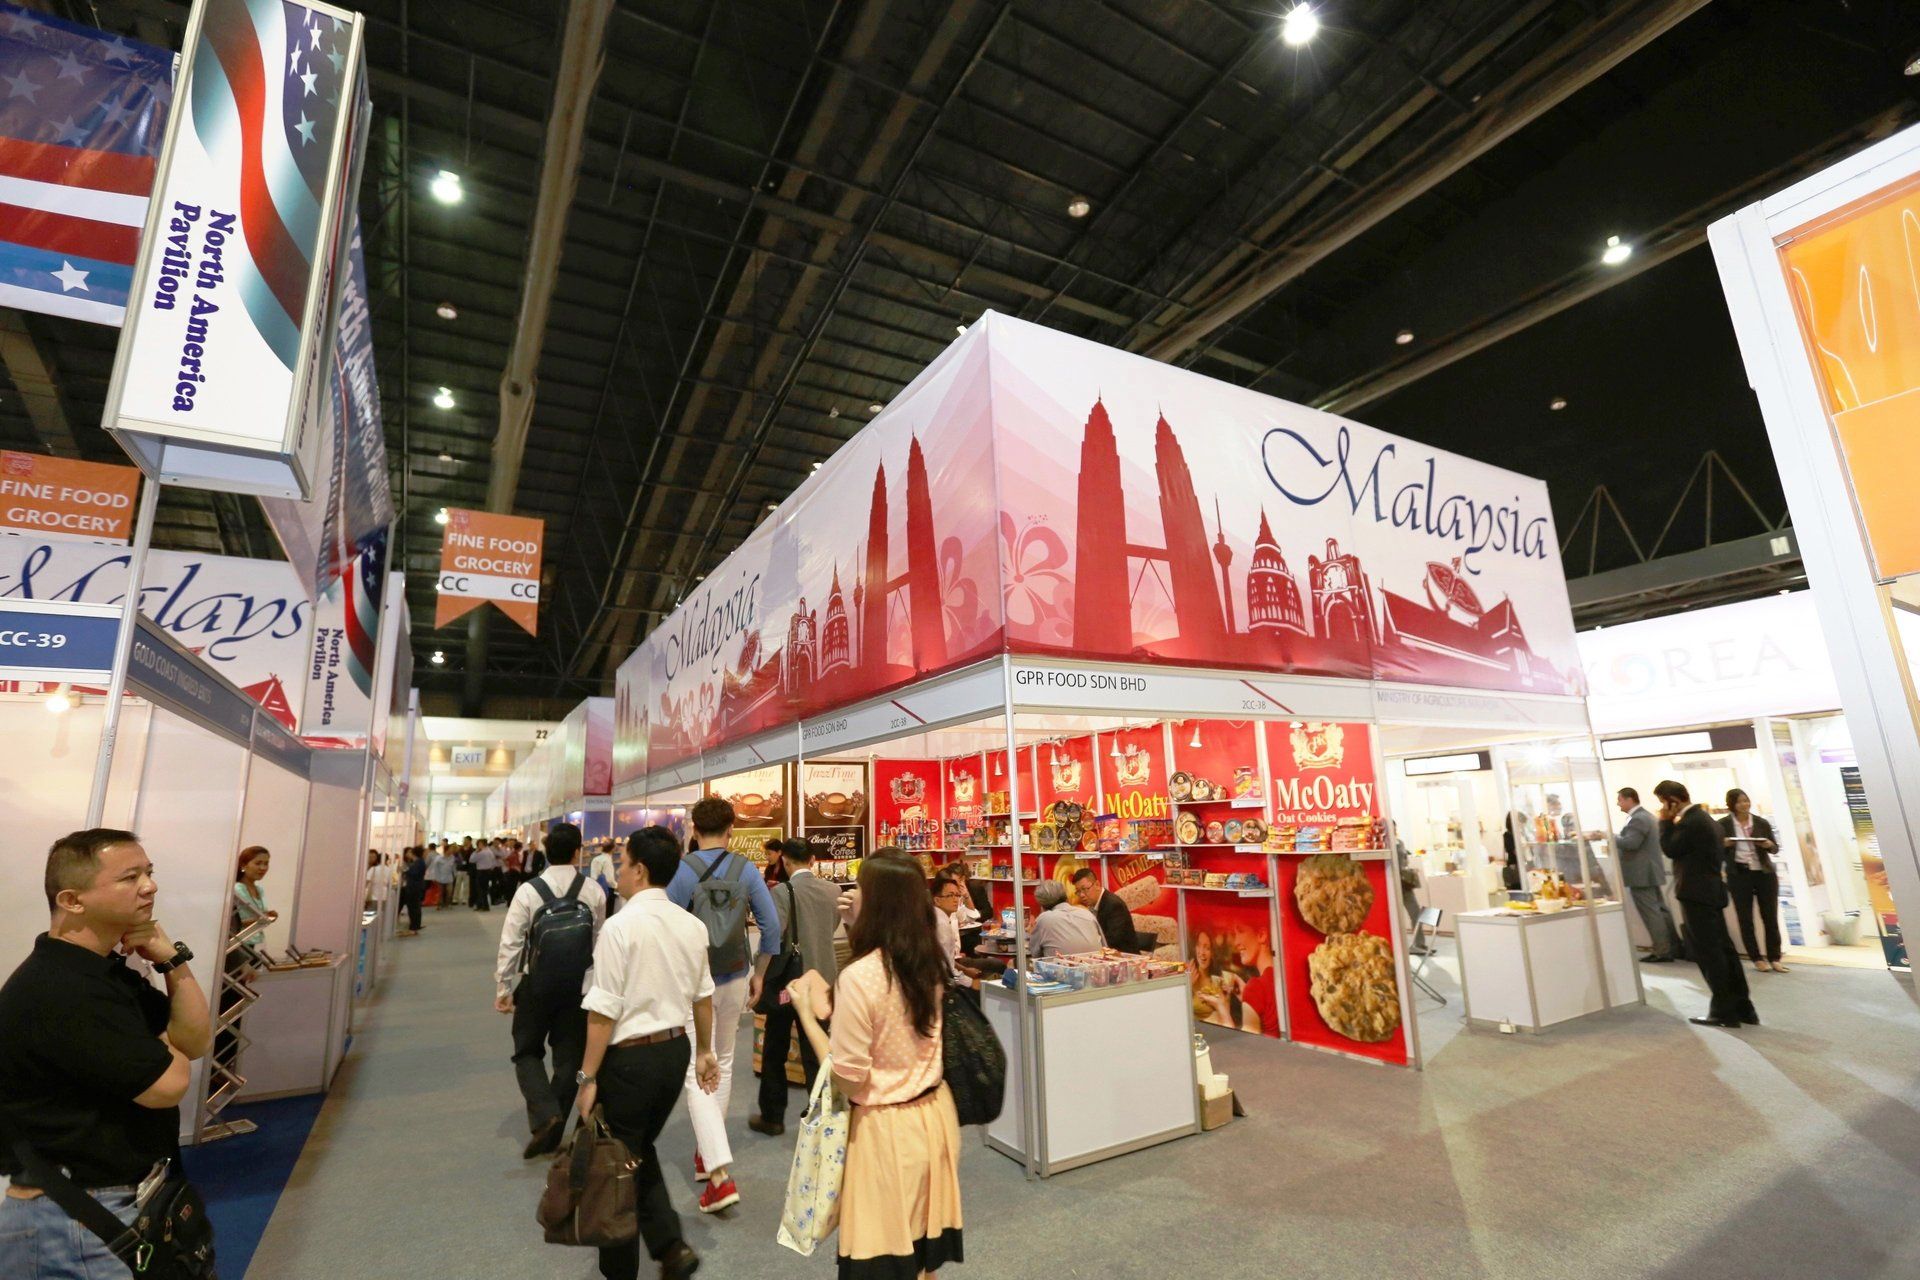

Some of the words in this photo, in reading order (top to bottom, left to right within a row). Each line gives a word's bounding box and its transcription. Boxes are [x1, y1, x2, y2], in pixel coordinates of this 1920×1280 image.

[153, 200, 202, 310] Pavilion
[196, 209, 237, 289] North
[172, 293, 220, 412] America
[0, 480, 55, 500] FINE
[60, 487, 129, 508] FOOD
[1261, 426, 1548, 576] Malaysia
[7, 507, 121, 532] GROCERY
[447, 532, 485, 549] FINE
[489, 538, 538, 555] FOOD
[454, 555, 532, 575] GROCERY
[441, 576, 469, 592] CC
[511, 583, 537, 599] CC
[665, 570, 760, 681] Malaysia
[312, 627, 329, 680] Pavilion
[328, 628, 344, 667] North
[133, 641, 155, 669] GOLD
[155, 655, 179, 684] COAST
[1016, 670, 1044, 686] GPR
[1048, 672, 1087, 688] FOOD
[1090, 674, 1117, 690] SDN
[1120, 677, 1147, 692] BHD
[322, 670, 339, 726] America
[1242, 699, 1267, 710] 2CC-38
[536, 729, 548, 739] 22
[455, 752, 482, 764] EXIT
[1106, 791, 1169, 820] McOaty
[1275, 775, 1373, 817] McOaty
[1278, 812, 1295, 823] Oat
[1298, 811, 1337, 823] Cookies
